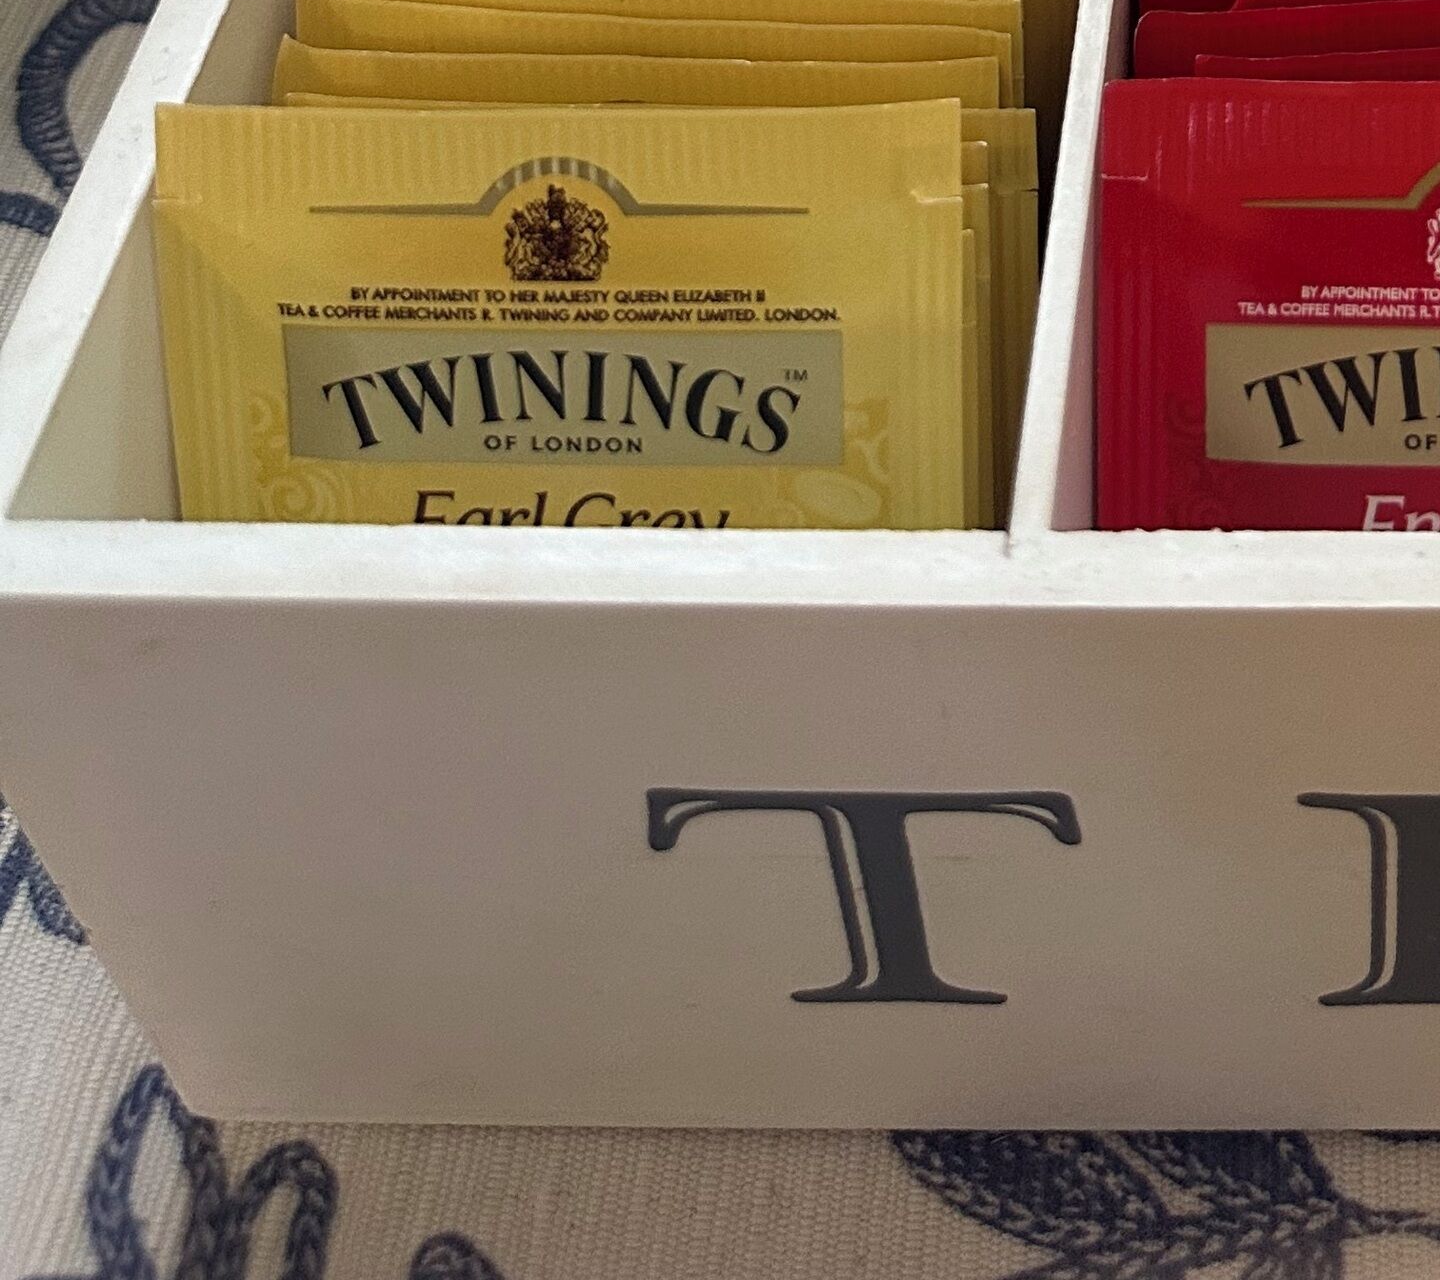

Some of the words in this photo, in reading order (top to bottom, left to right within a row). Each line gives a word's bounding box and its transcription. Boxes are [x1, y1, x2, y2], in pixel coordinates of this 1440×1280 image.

[351, 287, 370, 300] BY
[372, 287, 480, 302] APPOINTMENT
[485, 290, 506, 303] TO
[510, 290, 540, 303] HER
[543, 290, 609, 304] MAJESTY
[614, 290, 668, 303] QUEEN
[673, 289, 751, 303] ELIZABETH
[1301, 286, 1318, 298] BY
[1320, 286, 1417, 301] APPOINTMENT
[1422, 288, 1440, 300] TO
[277, 303, 304, 317] TEA
[308, 305, 319, 317] &
[323, 305, 380, 318] COFFEE
[385, 306, 477, 320] MERCHANTS
[499, 308, 570, 321] TWINING
[573, 308, 609, 321] AND
[613, 308, 693, 322] COMPANY
[1238, 302, 1264, 315] TEA
[1268, 303, 1277, 315] &
[1280, 303, 1330, 316] COFFEE
[1334, 303, 1415, 318] MERCHANTS
[322, 351, 801, 455] TWININGS
[484, 435, 517, 451] OF
[532, 436, 643, 453] LONDON
[1404, 434, 1437, 451] OF
